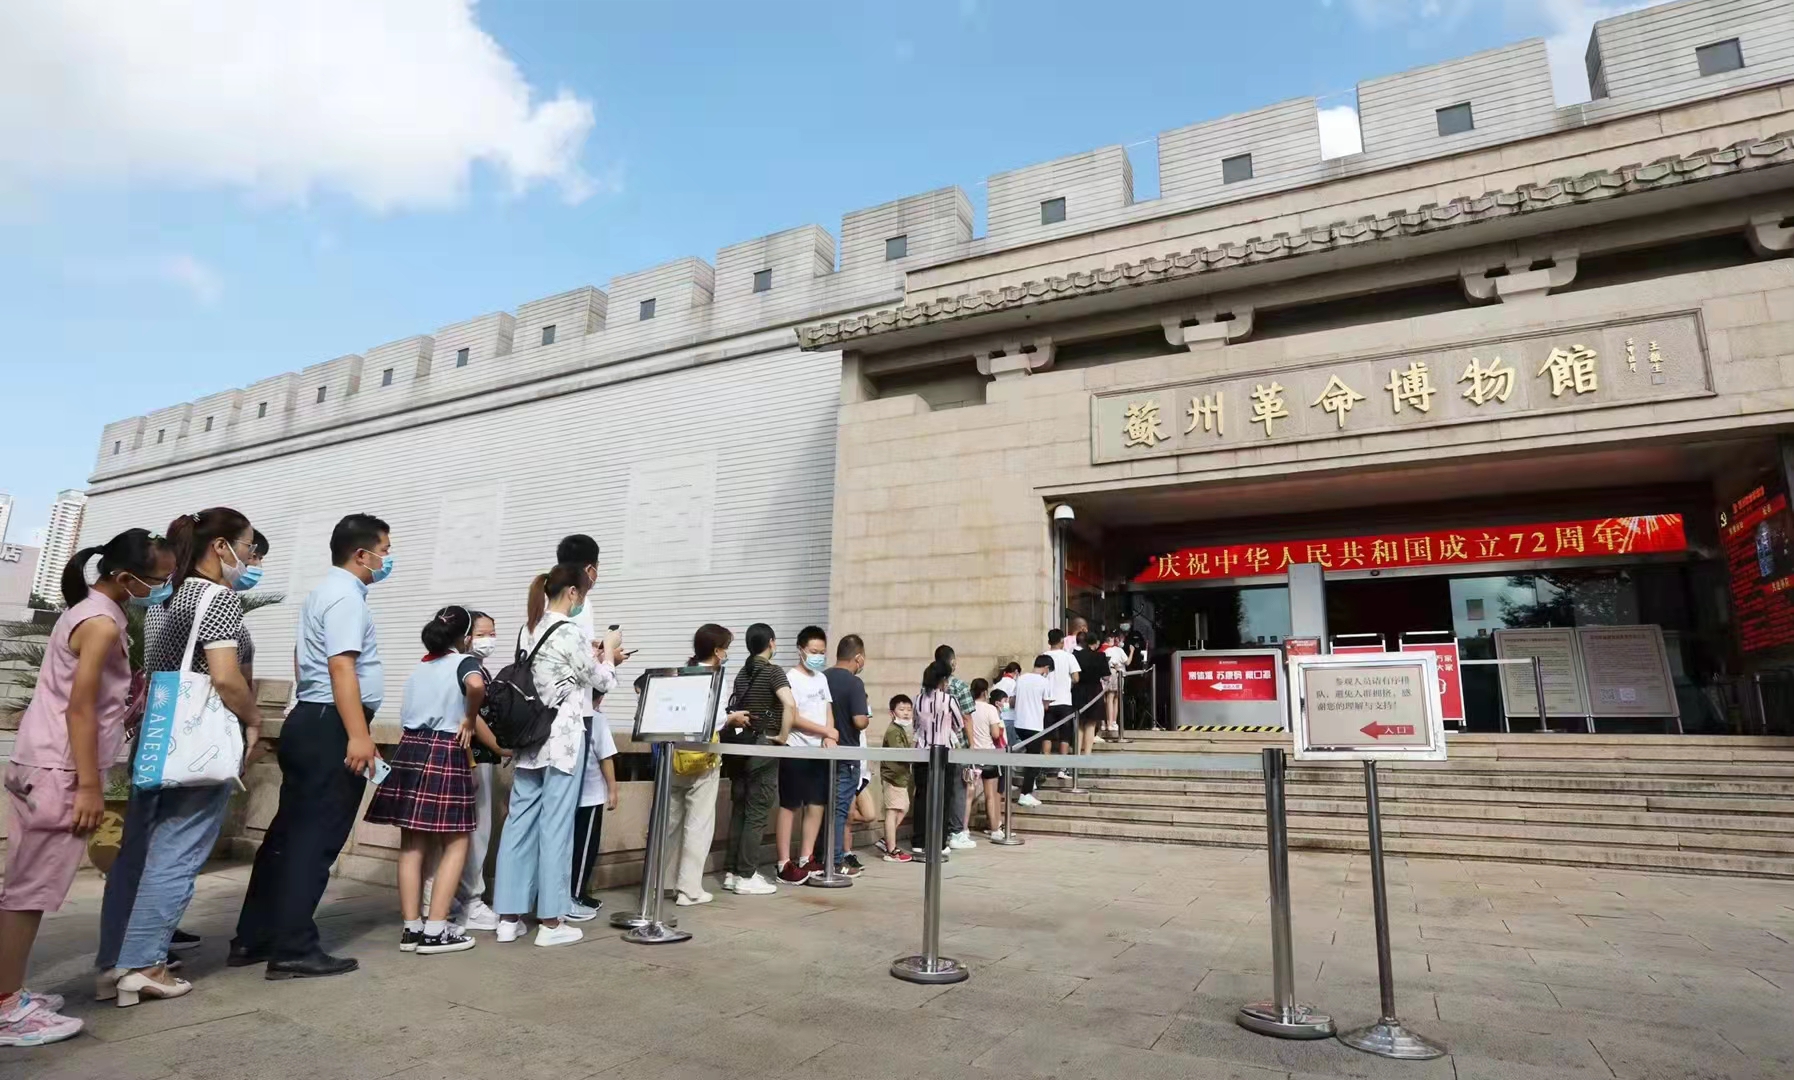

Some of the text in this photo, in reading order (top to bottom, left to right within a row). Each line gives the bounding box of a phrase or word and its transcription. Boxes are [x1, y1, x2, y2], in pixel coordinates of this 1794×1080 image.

[1123, 344, 1598, 447] 蘇州革命博物館
[1157, 518, 1627, 579] 庆祝中华人民共和国成立72周年
[136, 713, 167, 785] ANESSA
[1384, 725, 1407, 734] 入口
